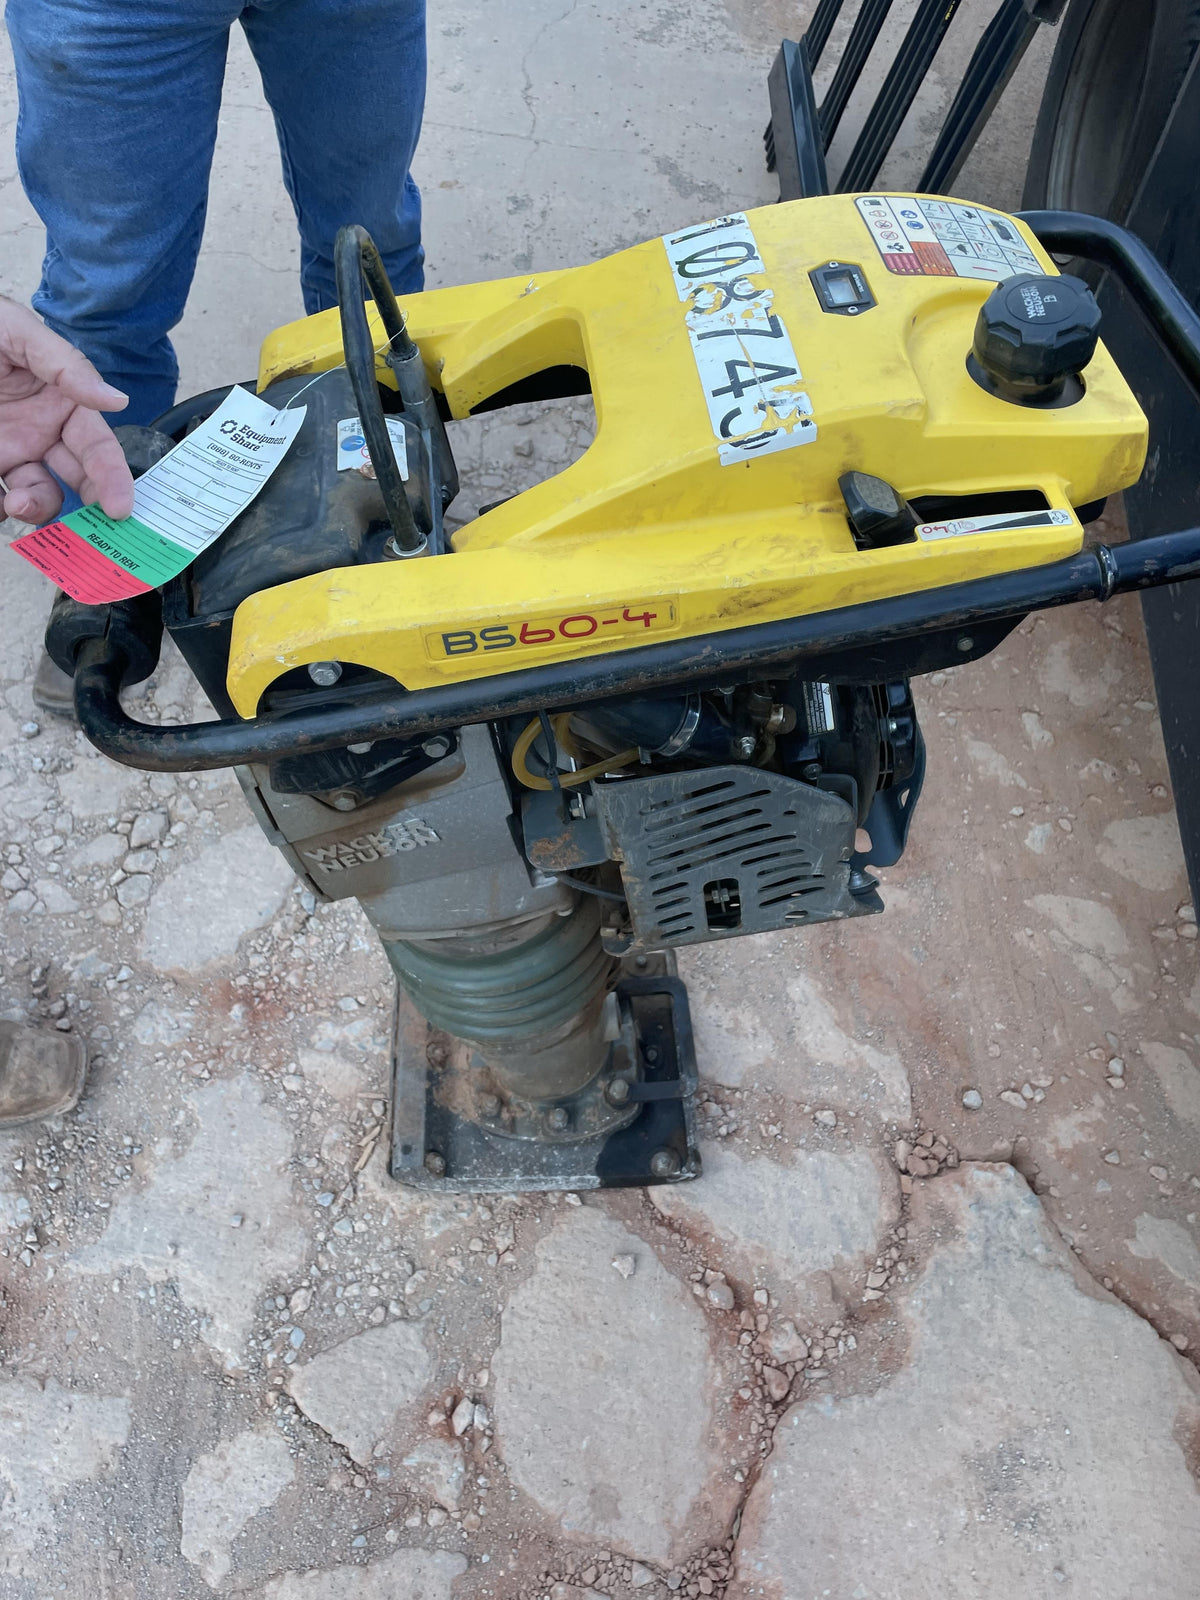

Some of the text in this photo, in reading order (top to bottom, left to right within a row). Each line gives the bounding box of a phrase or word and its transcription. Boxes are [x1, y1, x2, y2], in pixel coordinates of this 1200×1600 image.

[1021, 288, 1036, 318] WACKER
[1030, 286, 1046, 316] NEUSON
[230, 432, 260, 452] Share
[239, 425, 286, 445] Equipment
[87, 533, 140, 571] READY TO RENT
[442, 608, 657, 656] BS60-4
[304, 818, 429, 863] WACKER
[318, 830, 442, 874] NEUSON
